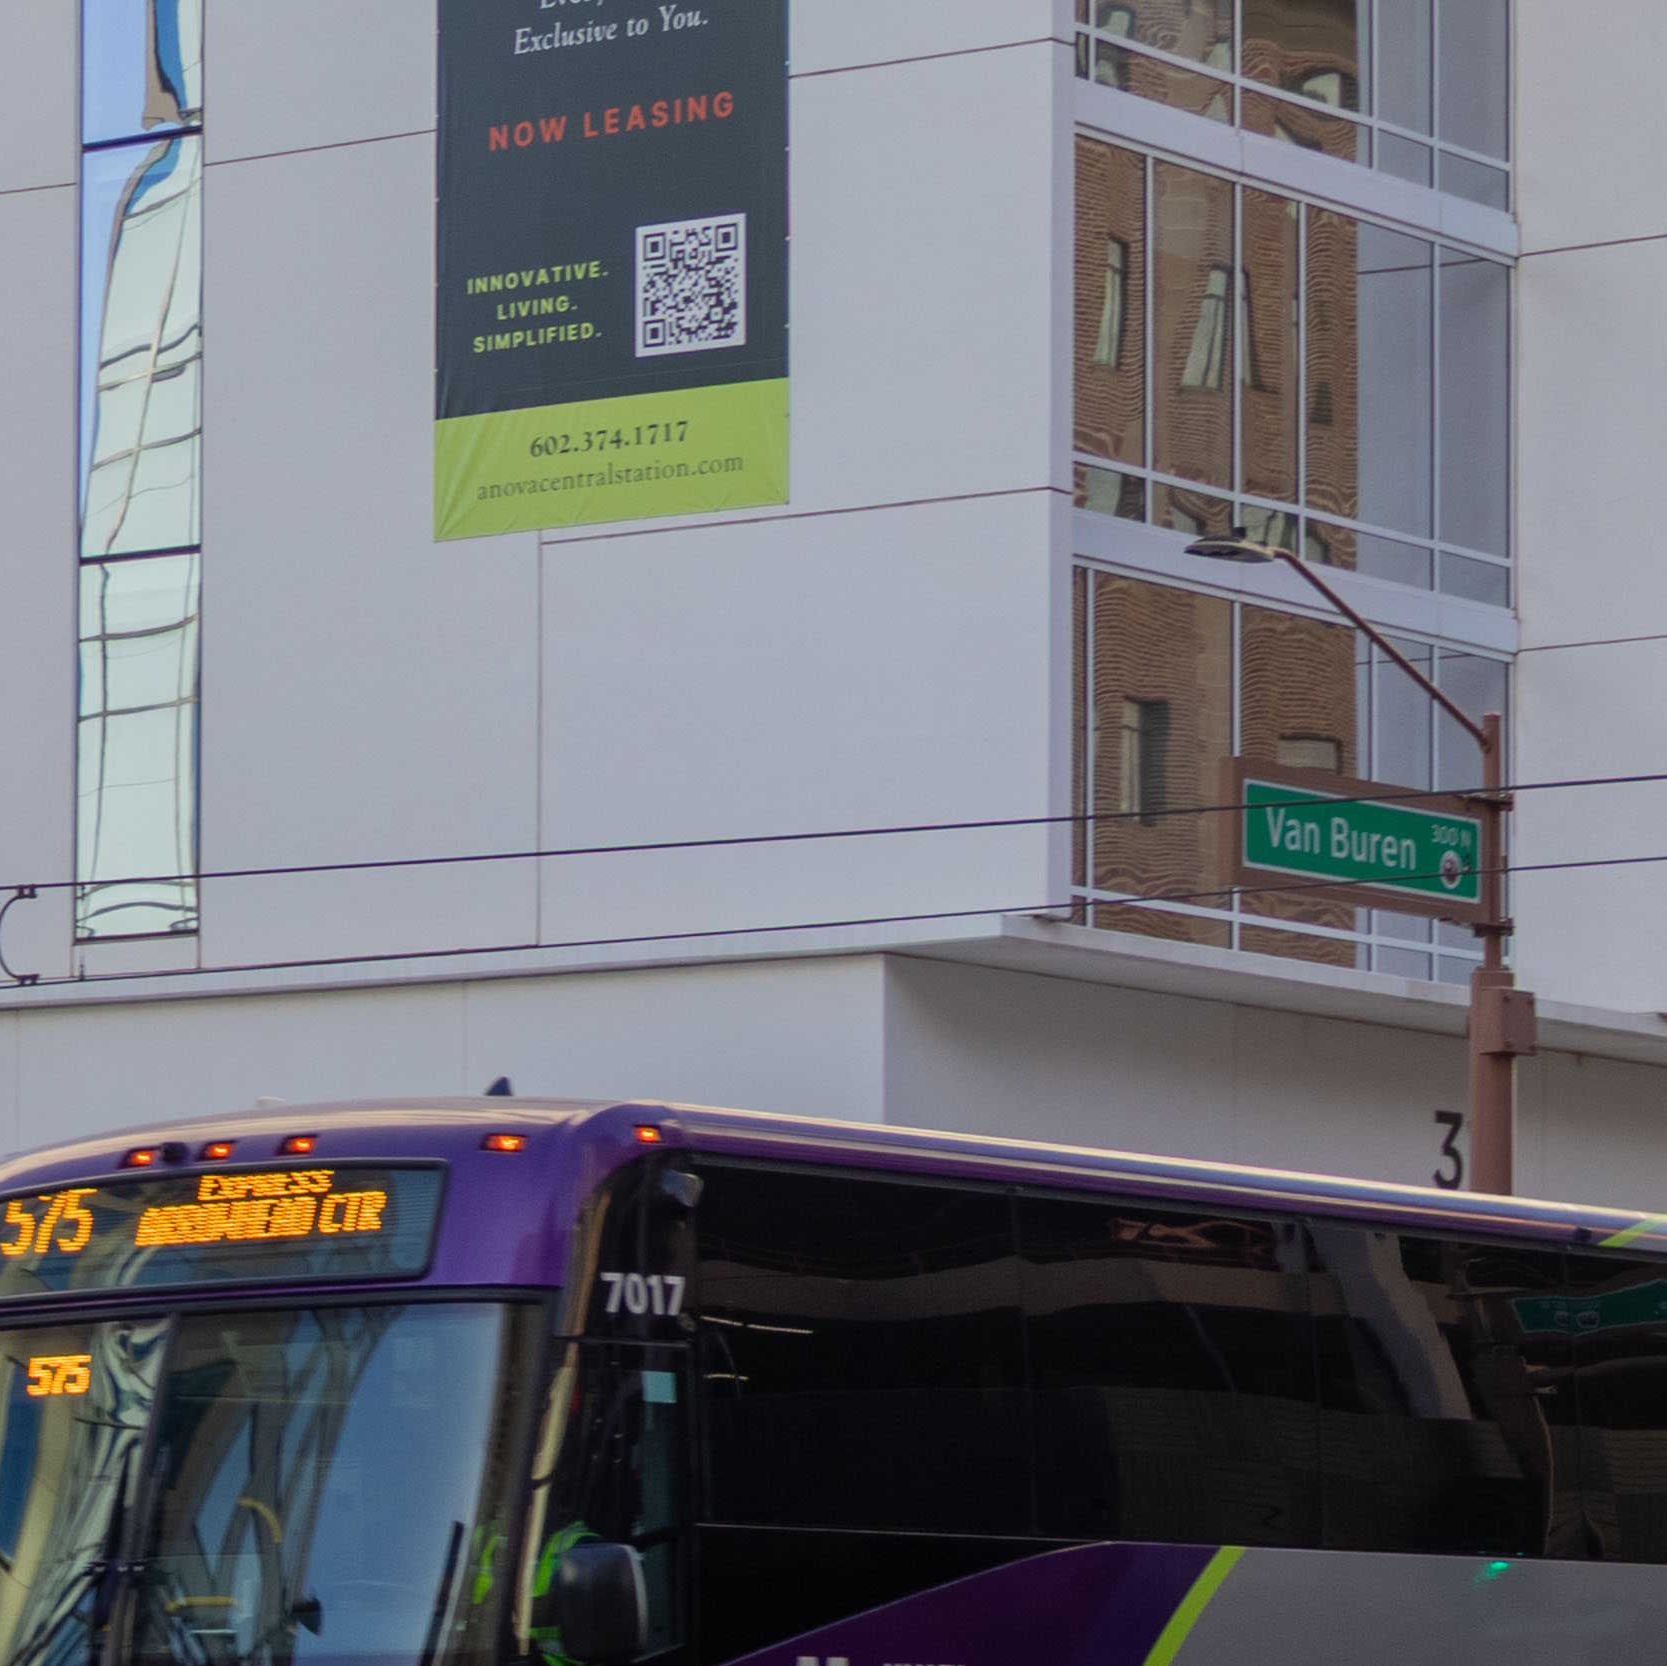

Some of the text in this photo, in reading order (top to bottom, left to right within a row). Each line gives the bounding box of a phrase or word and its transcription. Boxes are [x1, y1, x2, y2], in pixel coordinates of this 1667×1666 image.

[513, 3, 709, 55] Exclusive to You.
[488, 90, 734, 152] NOW LEASING
[466, 260, 609, 295] INNOVATIVE.
[496, 295, 578, 321] LIVING.
[472, 322, 603, 354] SIMPLIFIED.
[529, 419, 689, 458] 602.374.1717
[476, 455, 744, 501] anovacentralstation.com
[1265, 806, 1418, 871] Van Buren
[1433, 1109, 1463, 1191] 3
[197, 1169, 335, 1201] EXPRESS
[318, 1191, 387, 1234] CTR
[599, 1271, 686, 1316] 7017
[26, 1354, 92, 1397] 575
